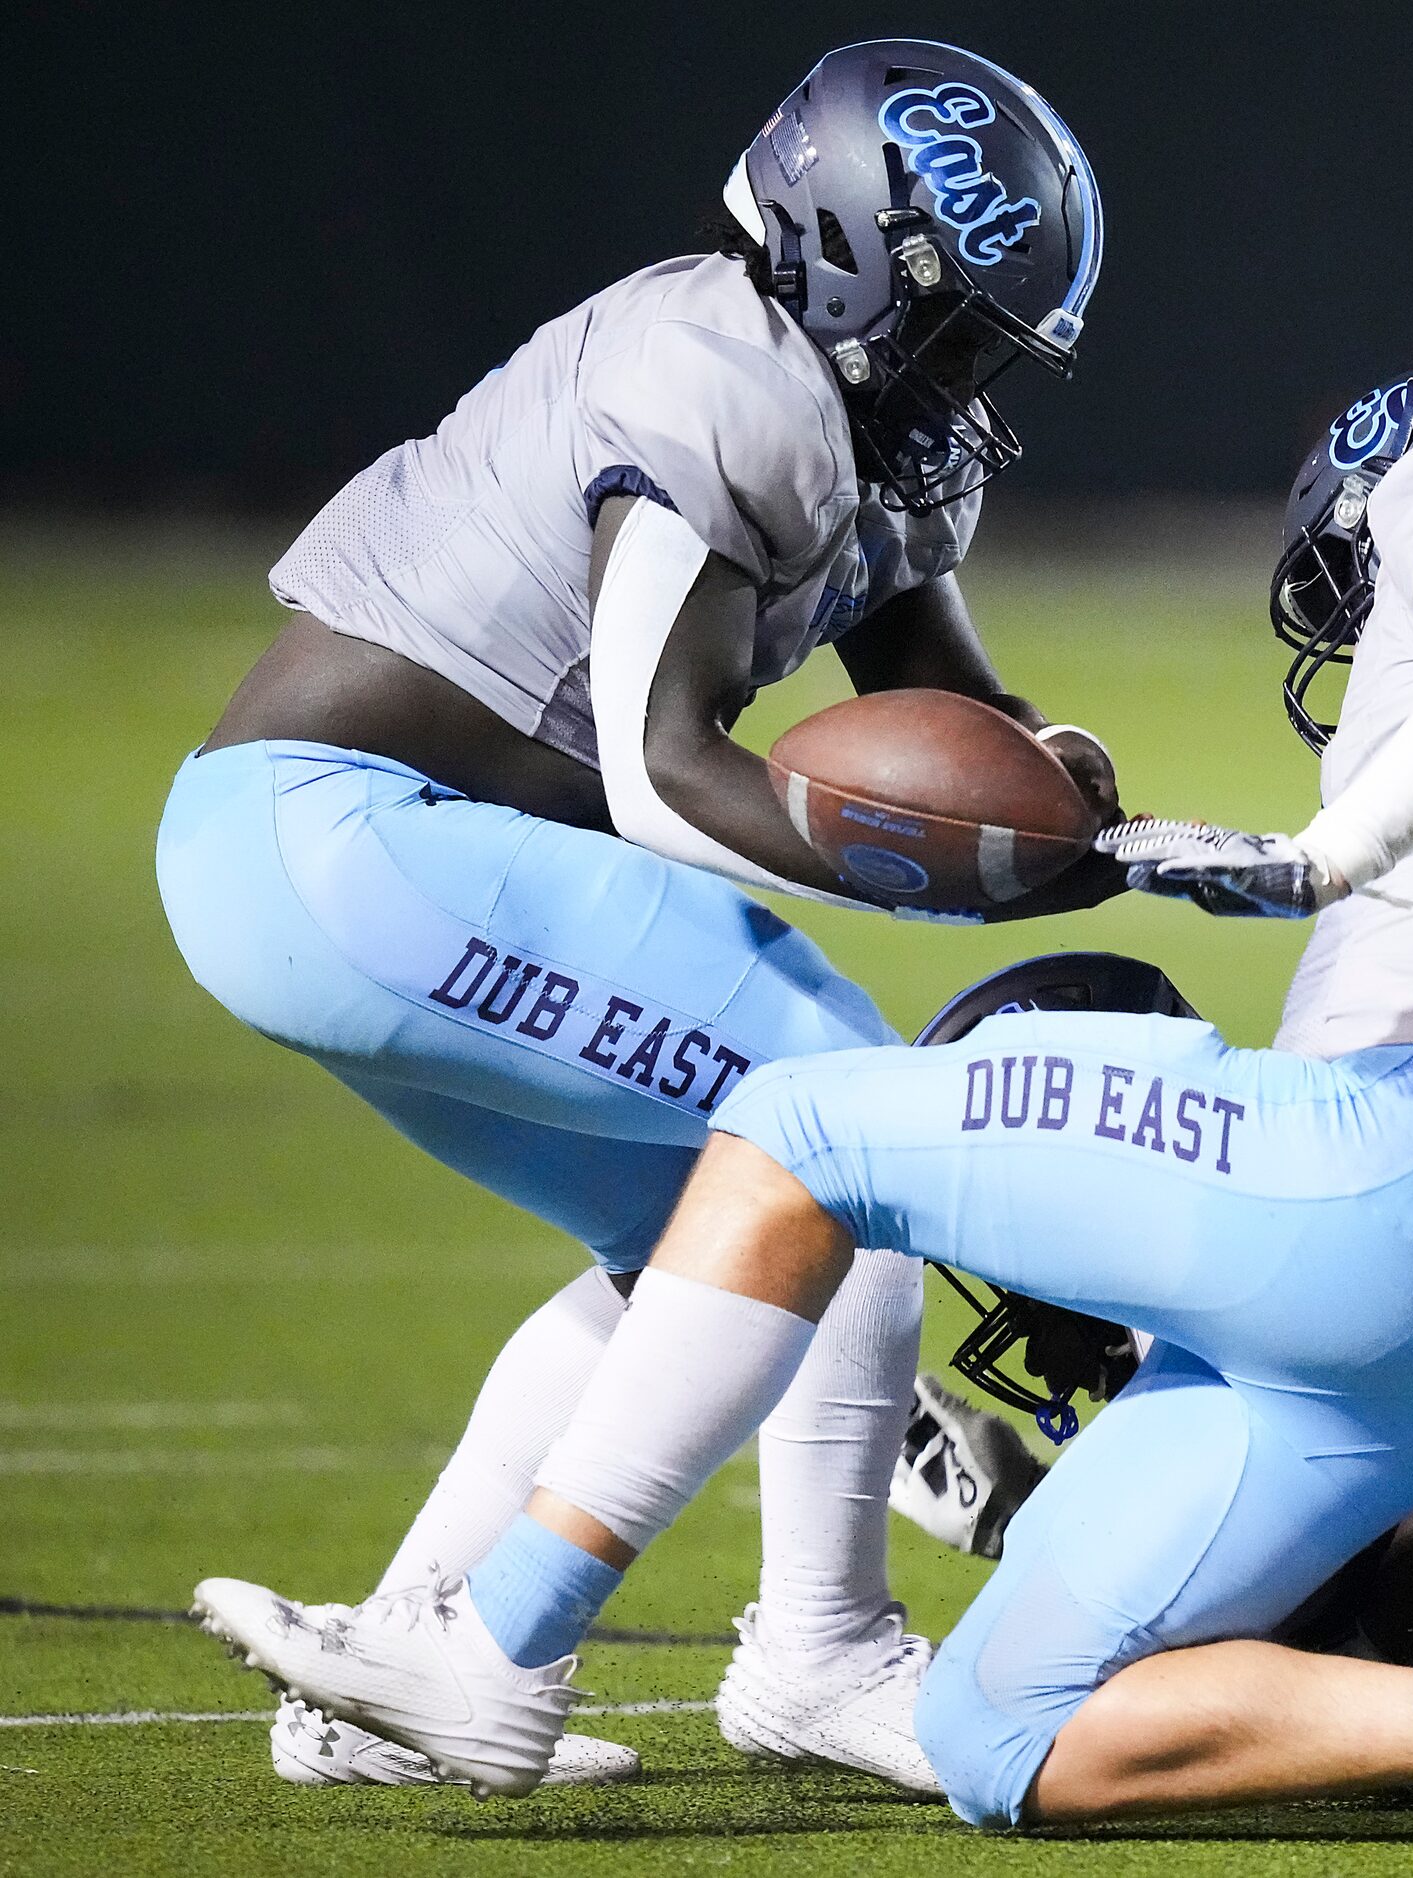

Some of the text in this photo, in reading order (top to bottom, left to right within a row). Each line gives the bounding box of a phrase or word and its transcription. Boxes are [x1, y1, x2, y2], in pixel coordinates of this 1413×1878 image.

[878, 82, 1041, 265] East
[428, 936, 751, 1112] DUB EAST
[961, 1055, 1245, 1175] DUB EAST
